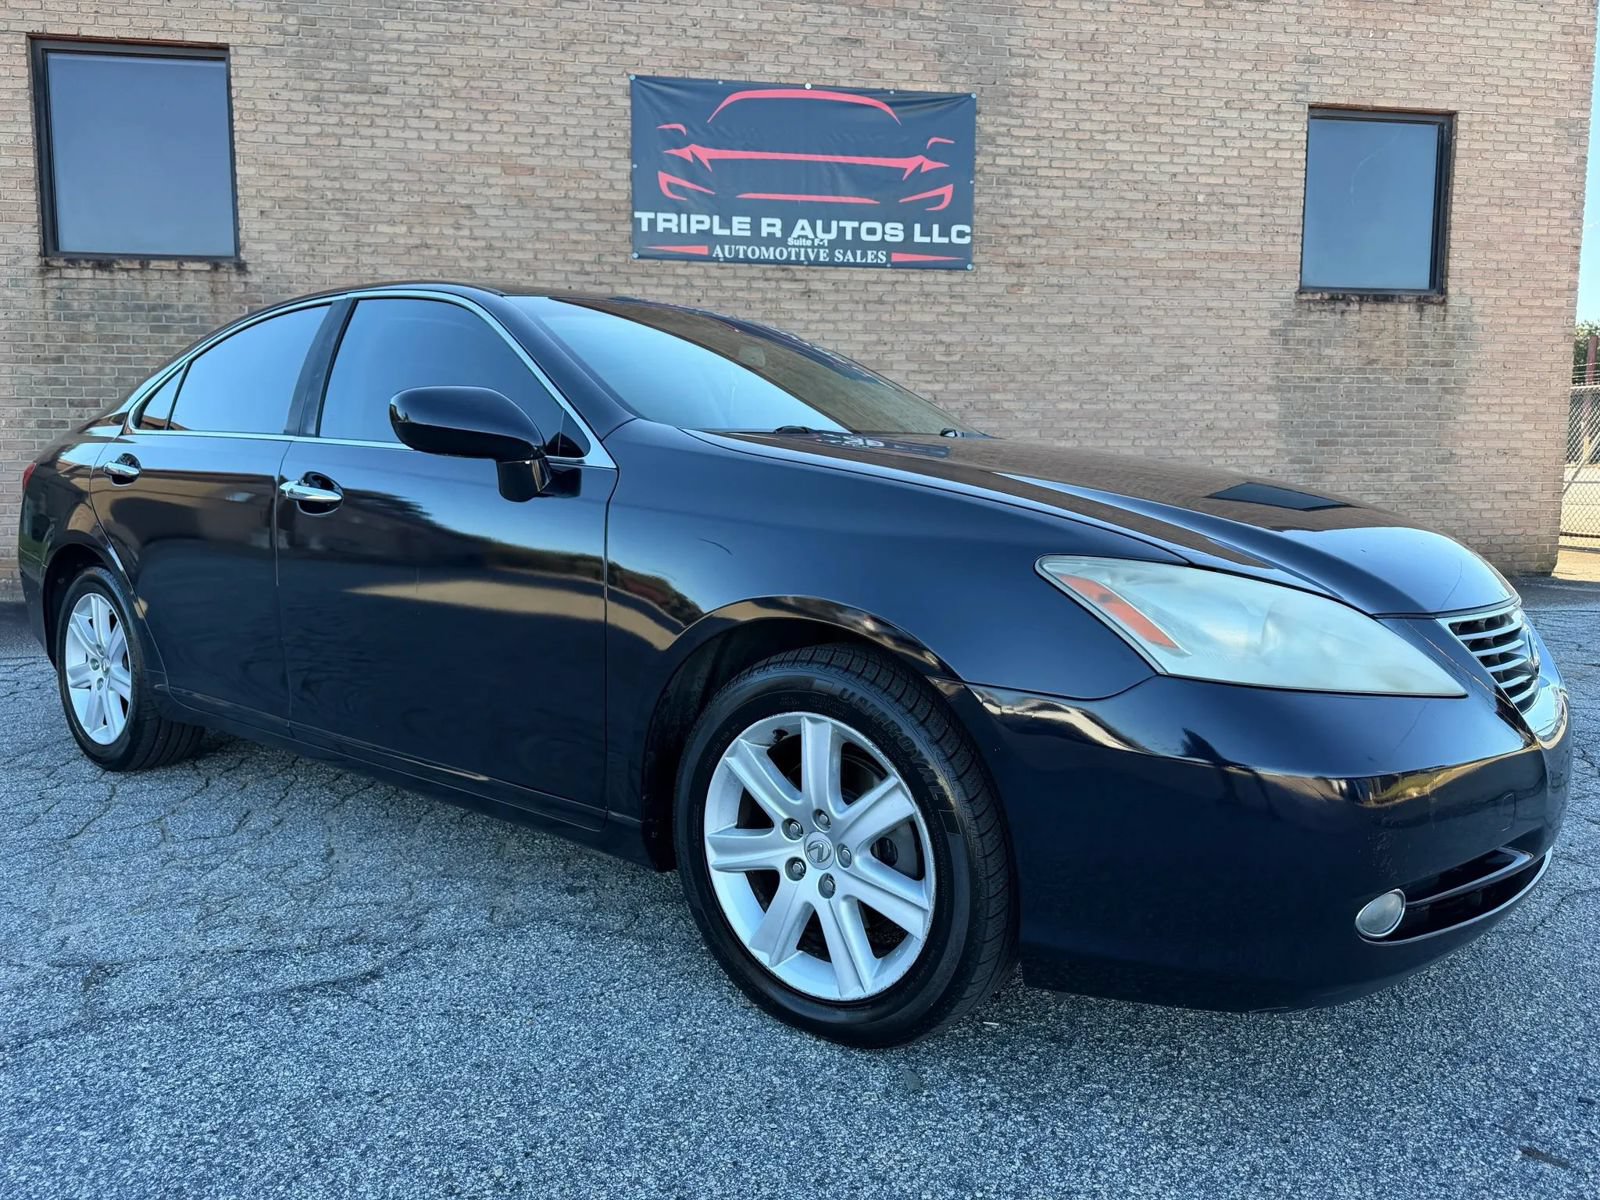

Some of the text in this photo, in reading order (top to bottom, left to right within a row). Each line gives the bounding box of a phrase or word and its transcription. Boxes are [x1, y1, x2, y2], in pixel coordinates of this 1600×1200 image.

[633, 211, 972, 245] TRIPLE R AUTOS LLC
[787, 236, 829, 247] Suite F-1
[712, 244, 888, 264] AUTOMOTIVE SALES
[838, 687, 946, 801] UNIROYAL
